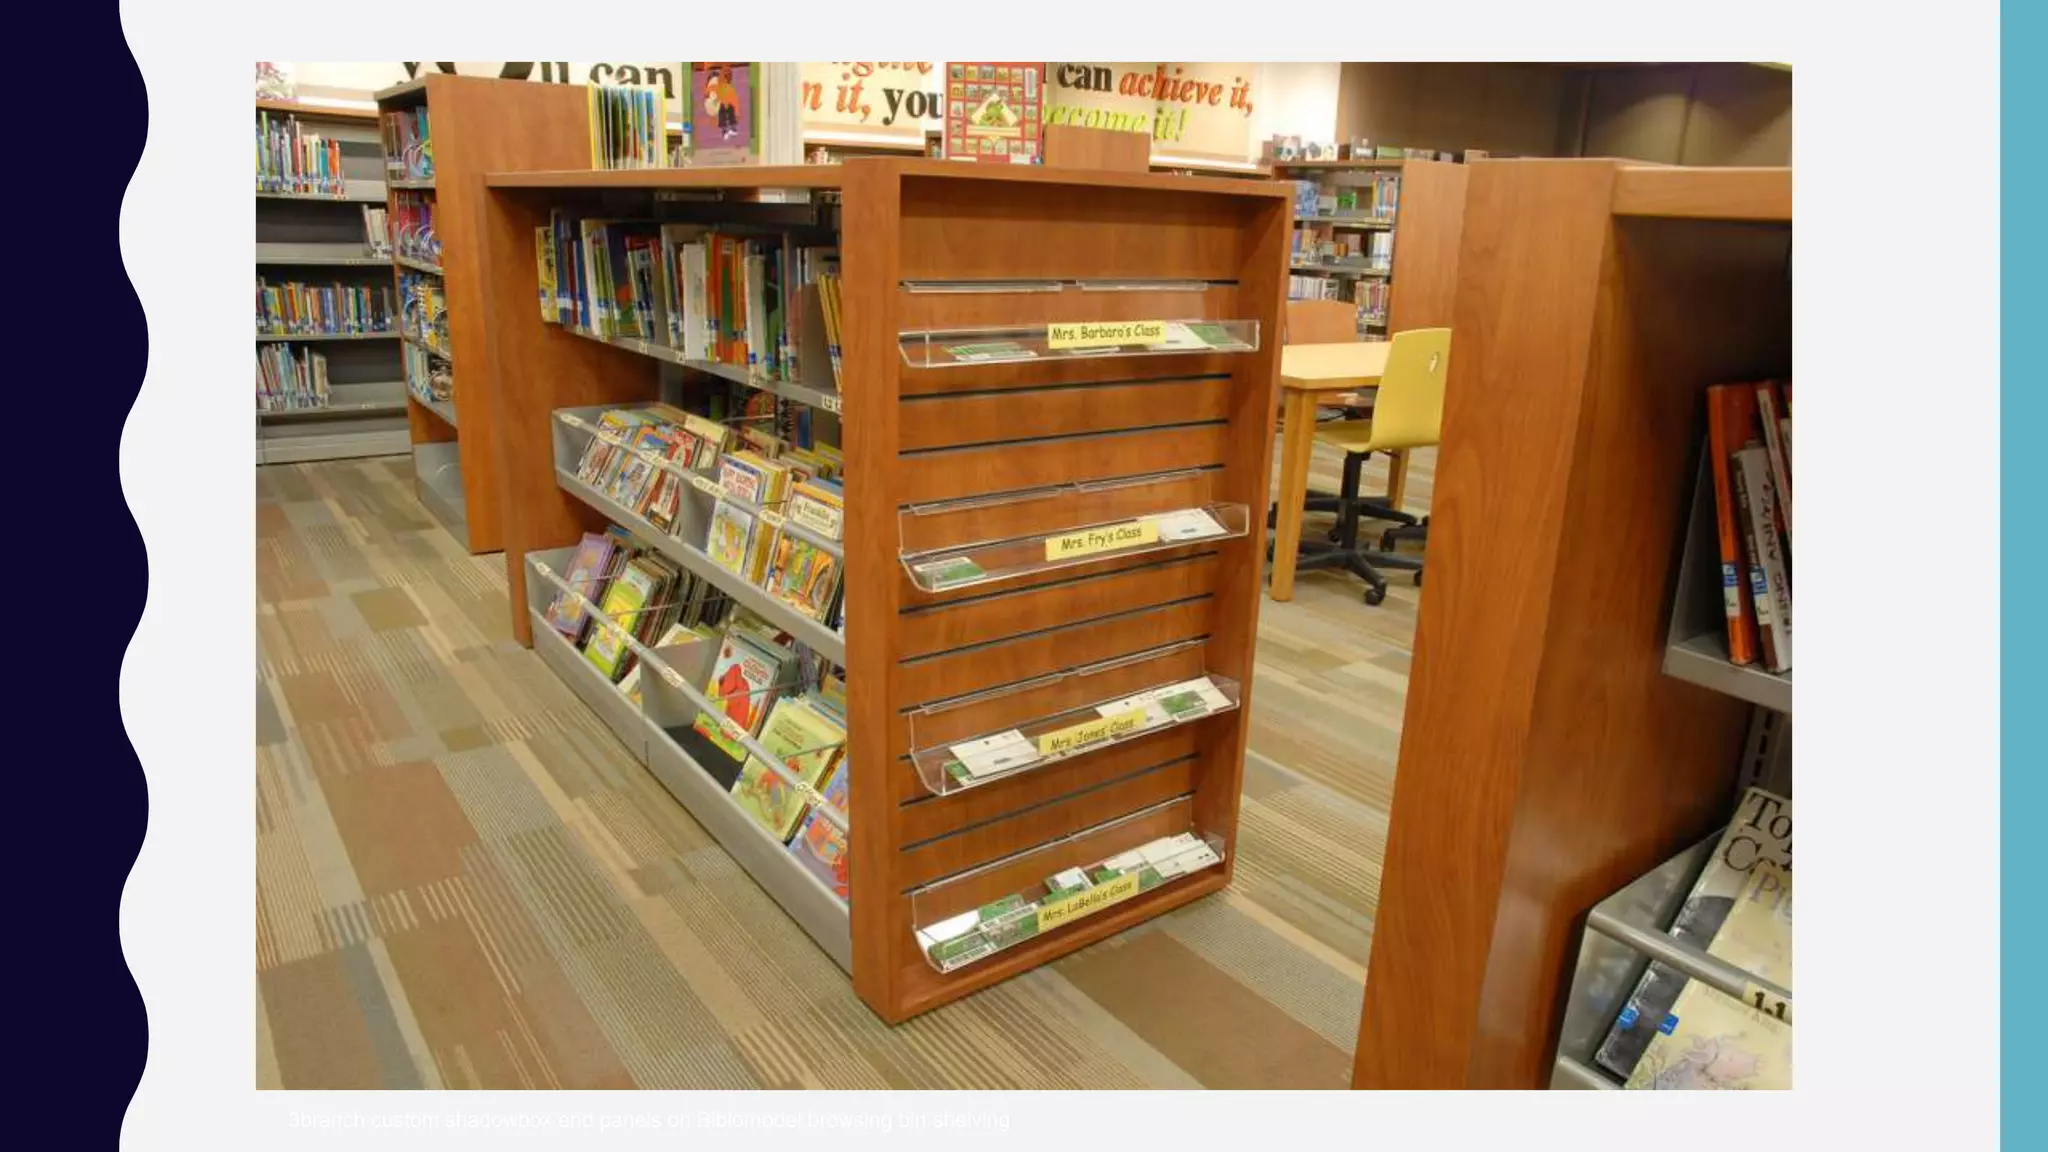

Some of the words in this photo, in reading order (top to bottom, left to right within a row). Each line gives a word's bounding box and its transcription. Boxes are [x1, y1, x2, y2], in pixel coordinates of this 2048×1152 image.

[1058, 62, 1112, 92] can
[1119, 64, 1224, 106] achieve
[882, 87, 945, 125] you
[1052, 327, 1077, 340] Mrs.
[1134, 324, 1161, 337] Class
[1115, 528, 1142, 540] Class
